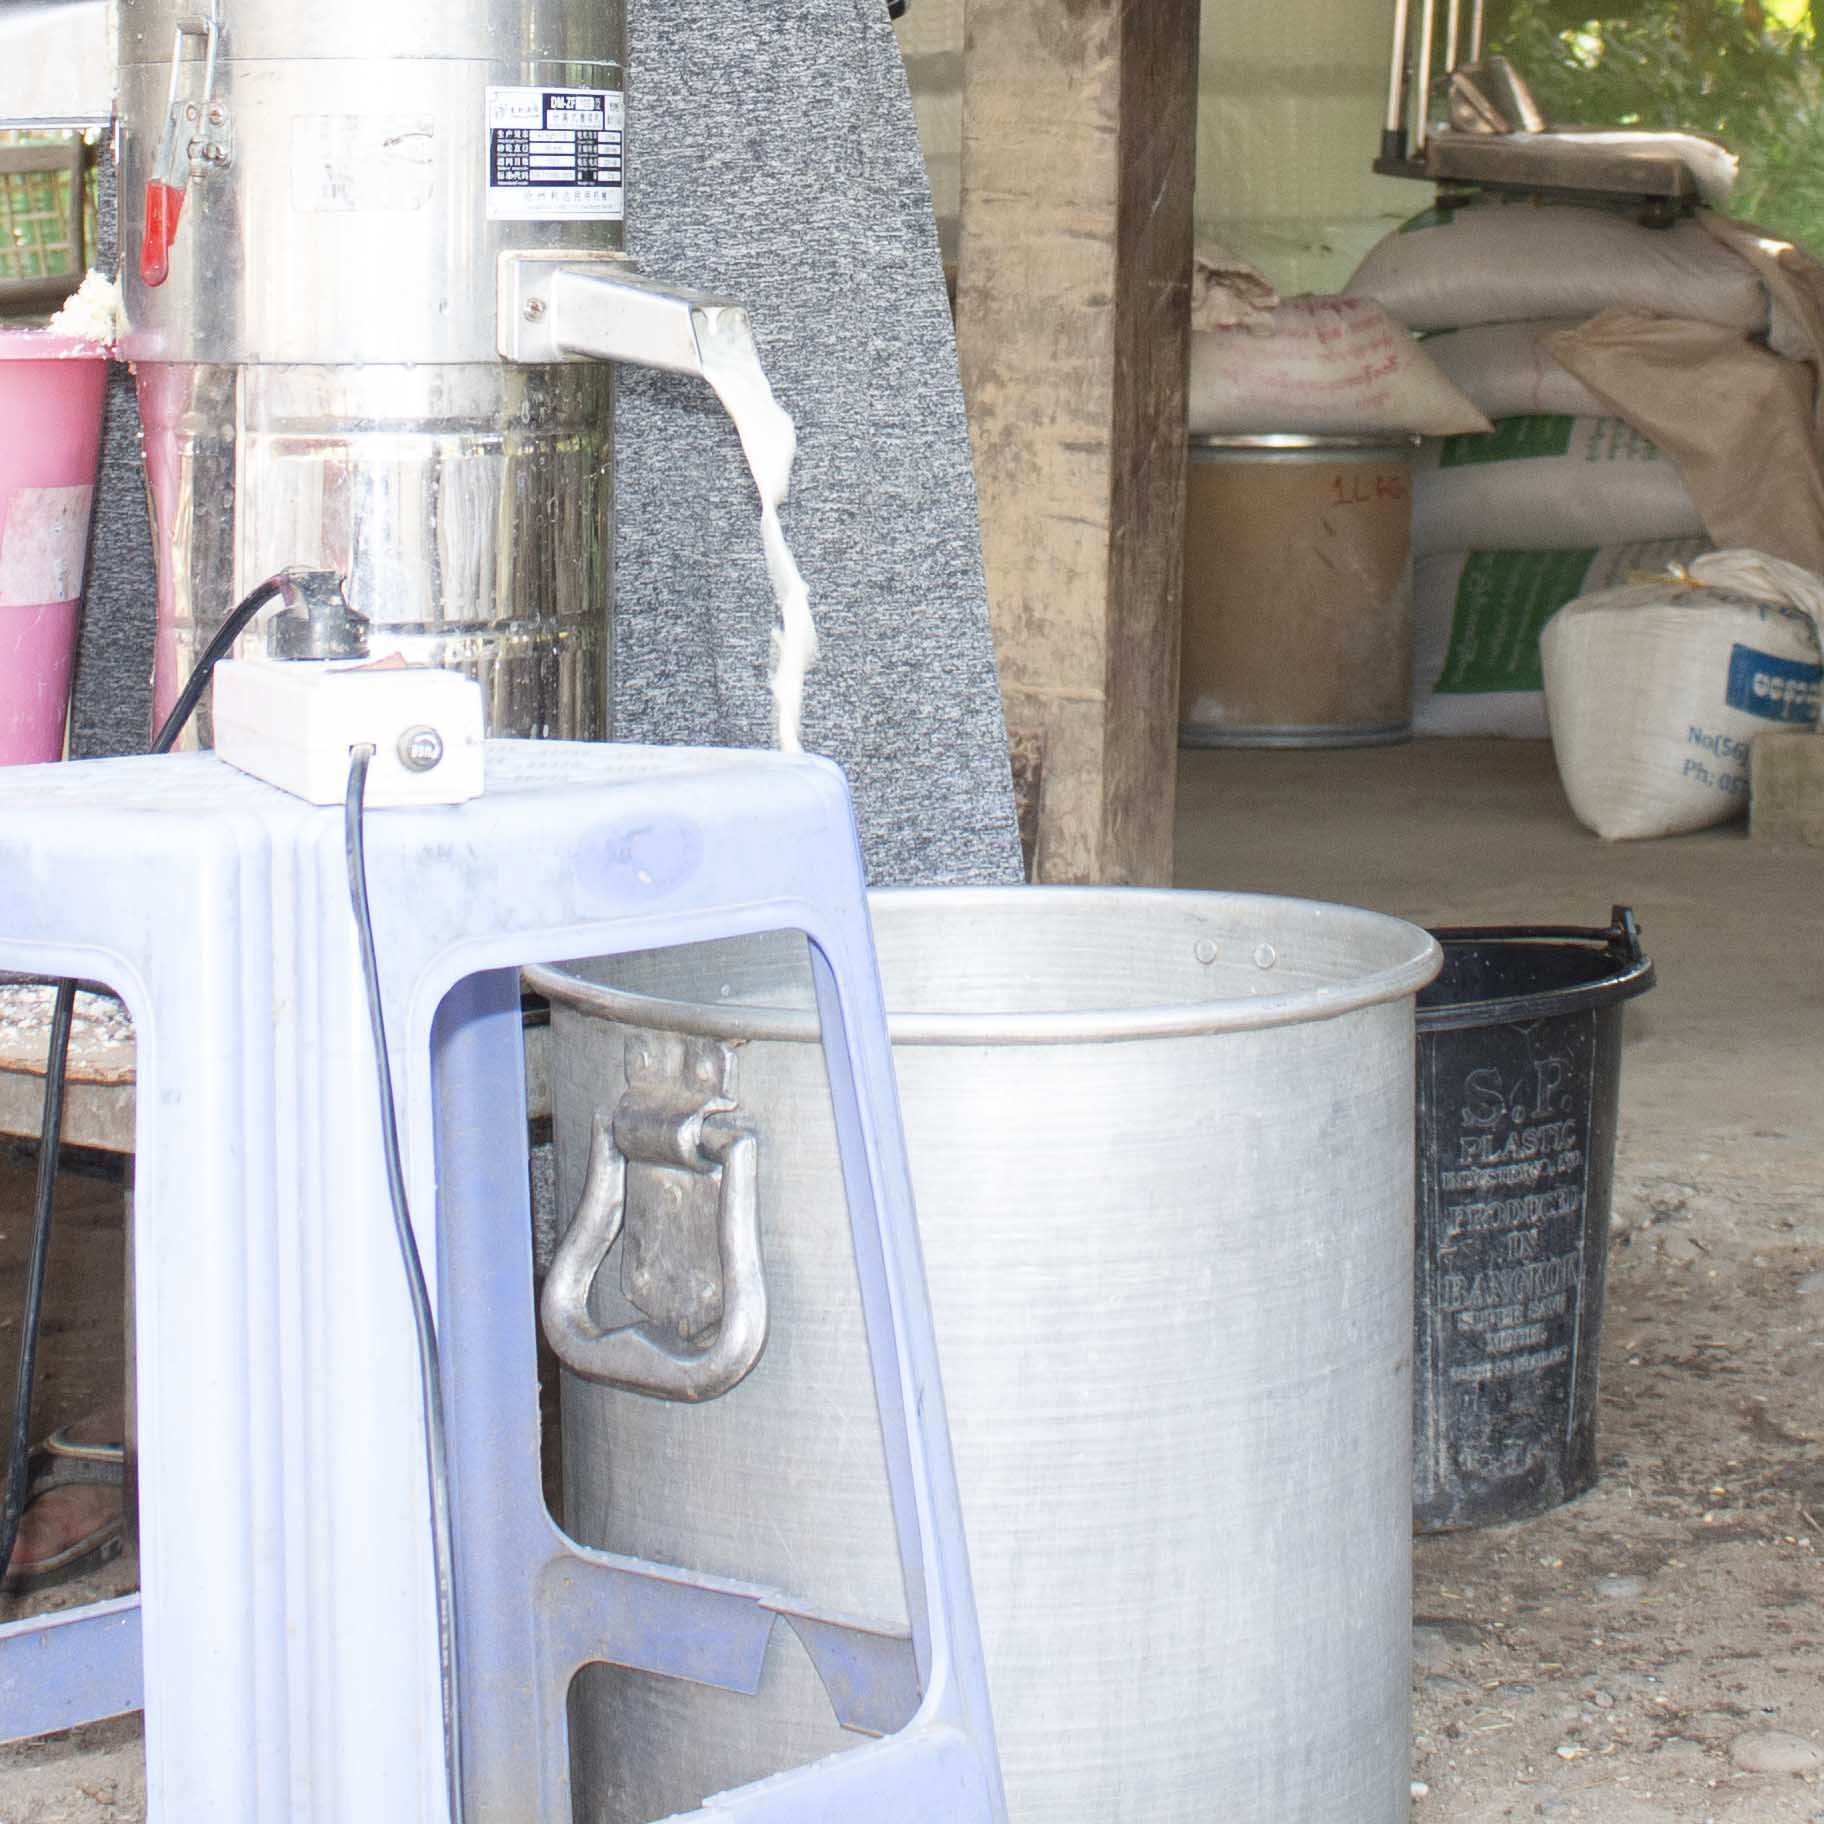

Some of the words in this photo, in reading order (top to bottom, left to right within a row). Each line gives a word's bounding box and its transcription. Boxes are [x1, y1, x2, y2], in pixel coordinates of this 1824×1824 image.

[1458, 1119, 1577, 1167] PLASTIC
[1446, 1188, 1578, 1238] PRODUCED
[1438, 1251, 1582, 1312] BANGKOK
